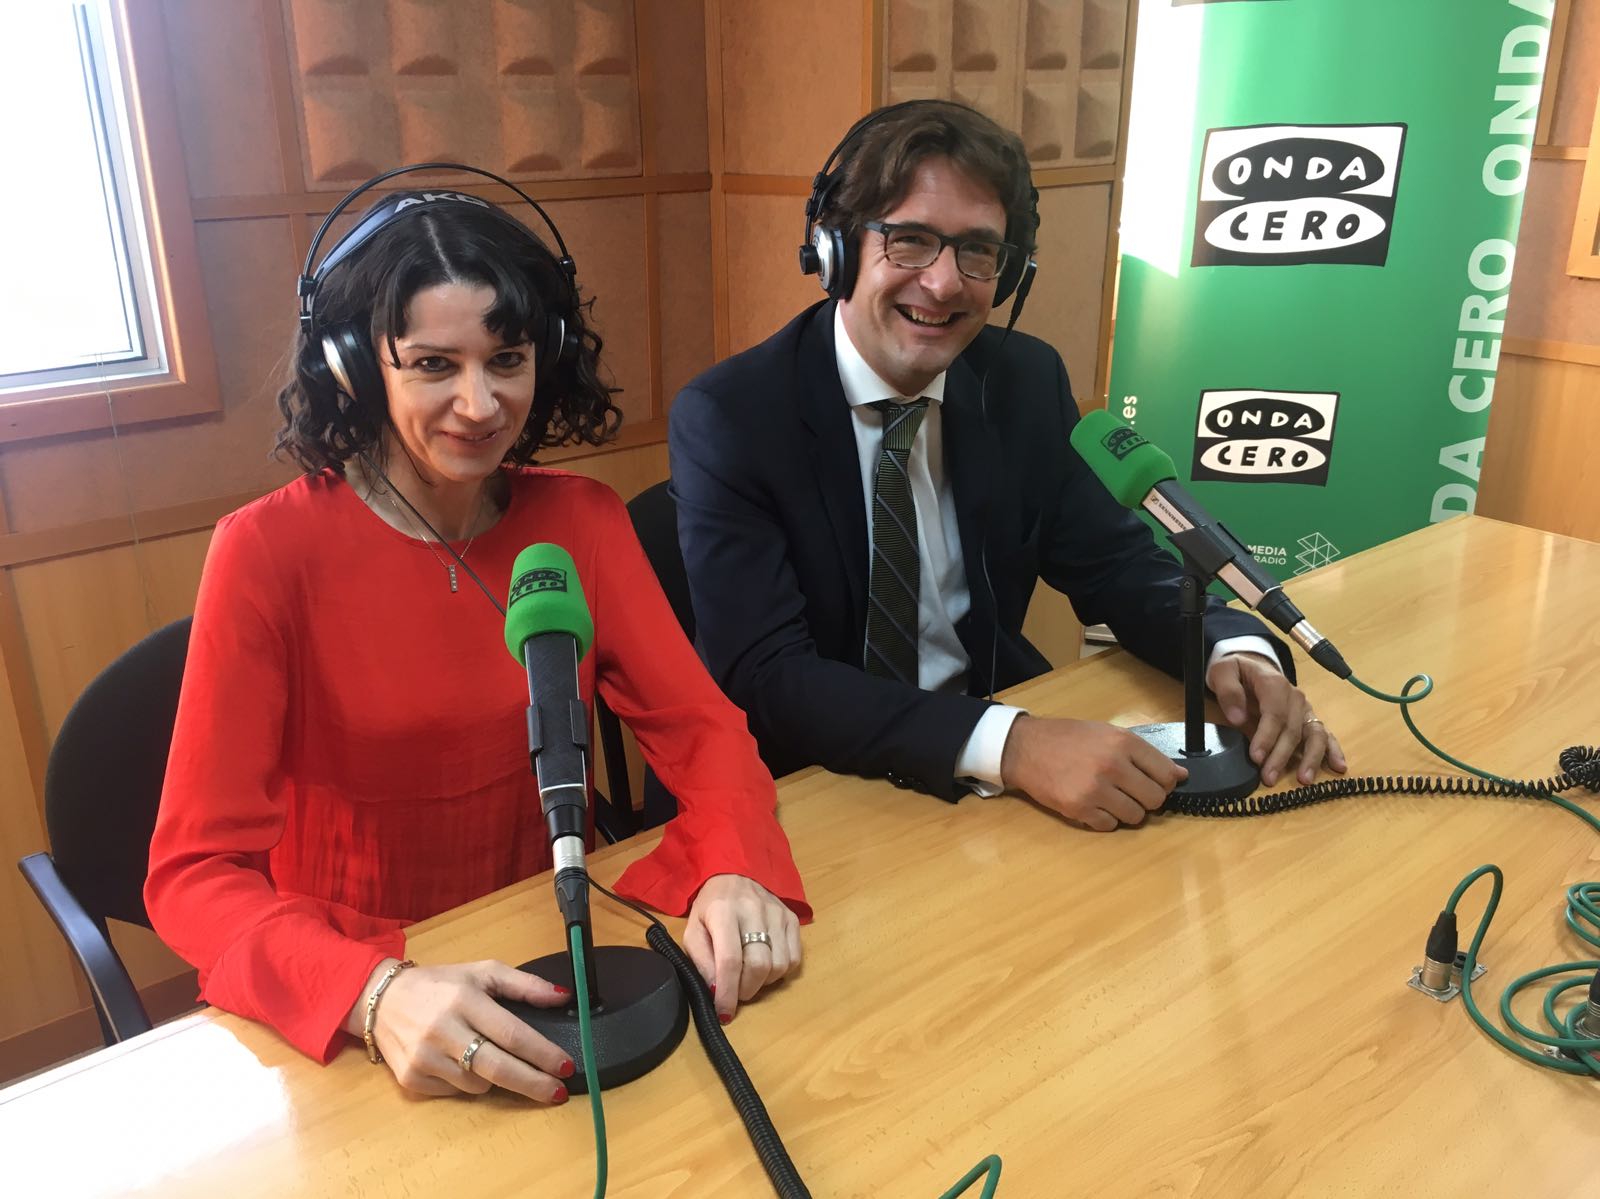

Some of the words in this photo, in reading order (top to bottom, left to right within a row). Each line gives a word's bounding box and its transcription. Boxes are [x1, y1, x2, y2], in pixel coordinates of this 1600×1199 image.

[1228, 155, 1367, 186] ONDA
[1229, 210, 1361, 241] CERO
[1448, 238, 1516, 413] CERO
[1216, 409, 1313, 429] ONDA
[1217, 445, 1309, 468] CERO
